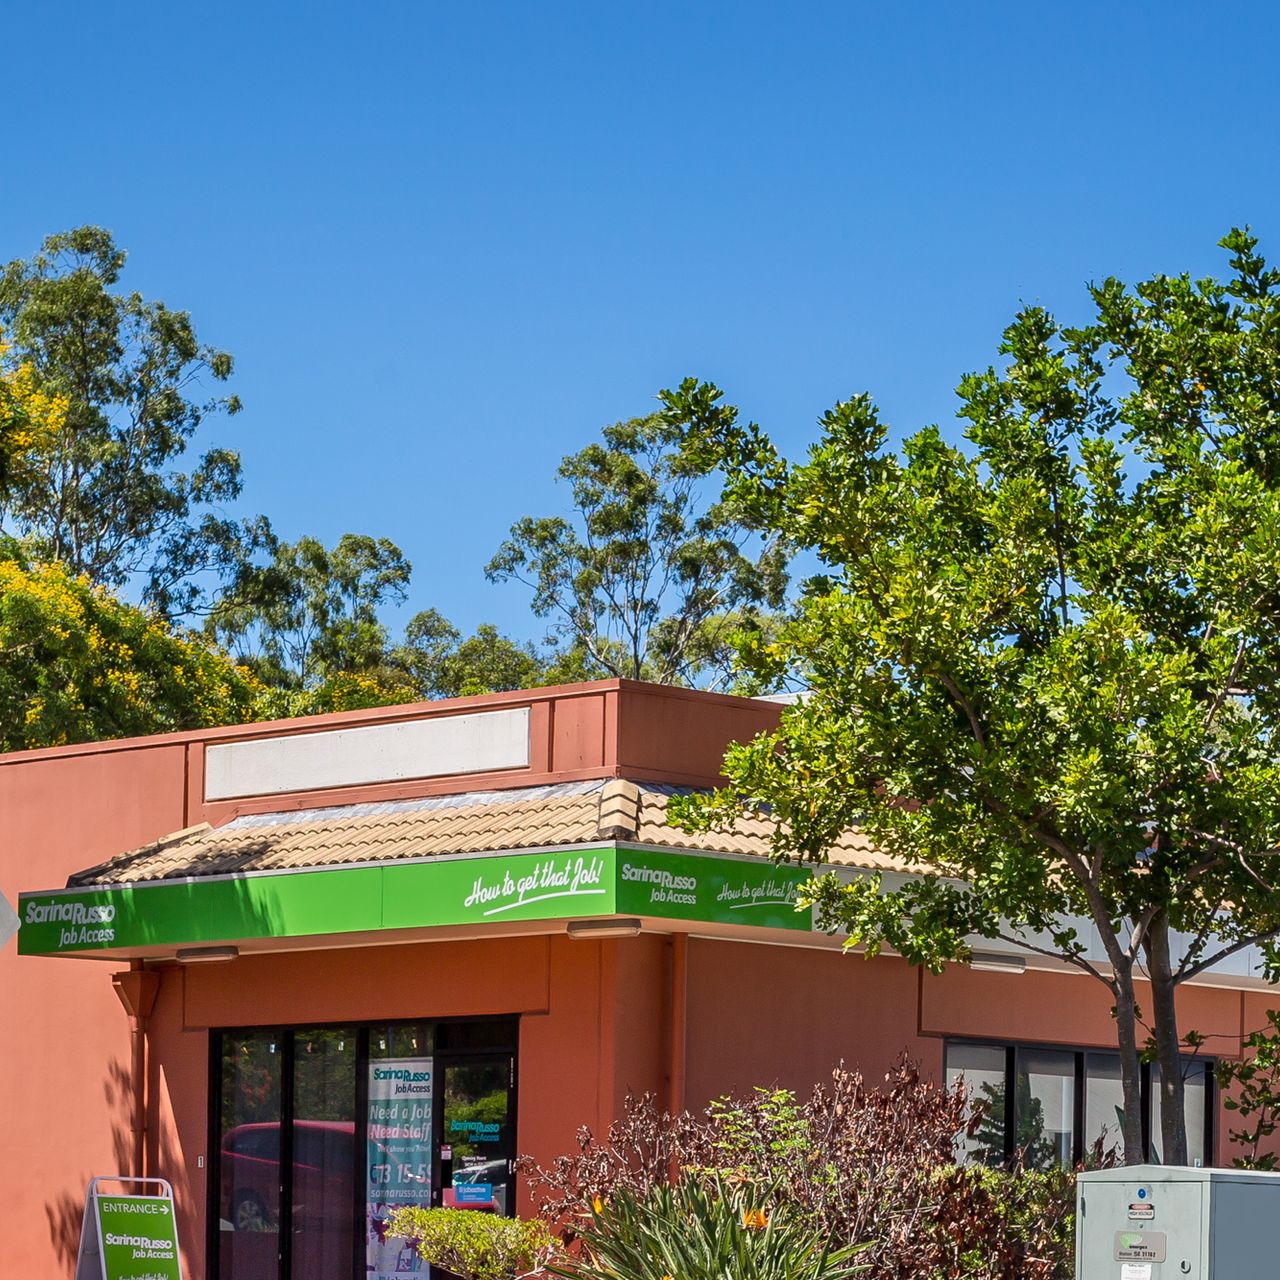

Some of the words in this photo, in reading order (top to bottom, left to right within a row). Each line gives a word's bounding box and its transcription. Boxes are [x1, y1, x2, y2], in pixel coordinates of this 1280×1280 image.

[464, 877, 500, 907] How
[502, 871, 515, 896] to
[517, 864, 539, 902] get
[540, 859, 571, 888] that
[570, 857, 604, 893] Job!
[650, 887, 666, 902] Job
[668, 889, 696, 905] Access
[717, 882, 740, 902] How
[741, 881, 751, 897] to
[752, 880, 766, 904] get
[767, 880, 786, 898] that
[59, 927, 77, 947] Job
[79, 926, 115, 943] Access
[395, 1084, 407, 1095] Job
[407, 1083, 430, 1093] Access
[370, 1104, 397, 1120] Need
[402, 1107, 408, 1119] a
[410, 1103, 431, 1121] Job
[370, 1123, 399, 1139] Need
[403, 1122, 431, 1142] Staff
[103, 1202, 158, 1214] ENTRANCE
[132, 1249, 146, 1259] Job
[147, 1249, 173, 1259] Access
